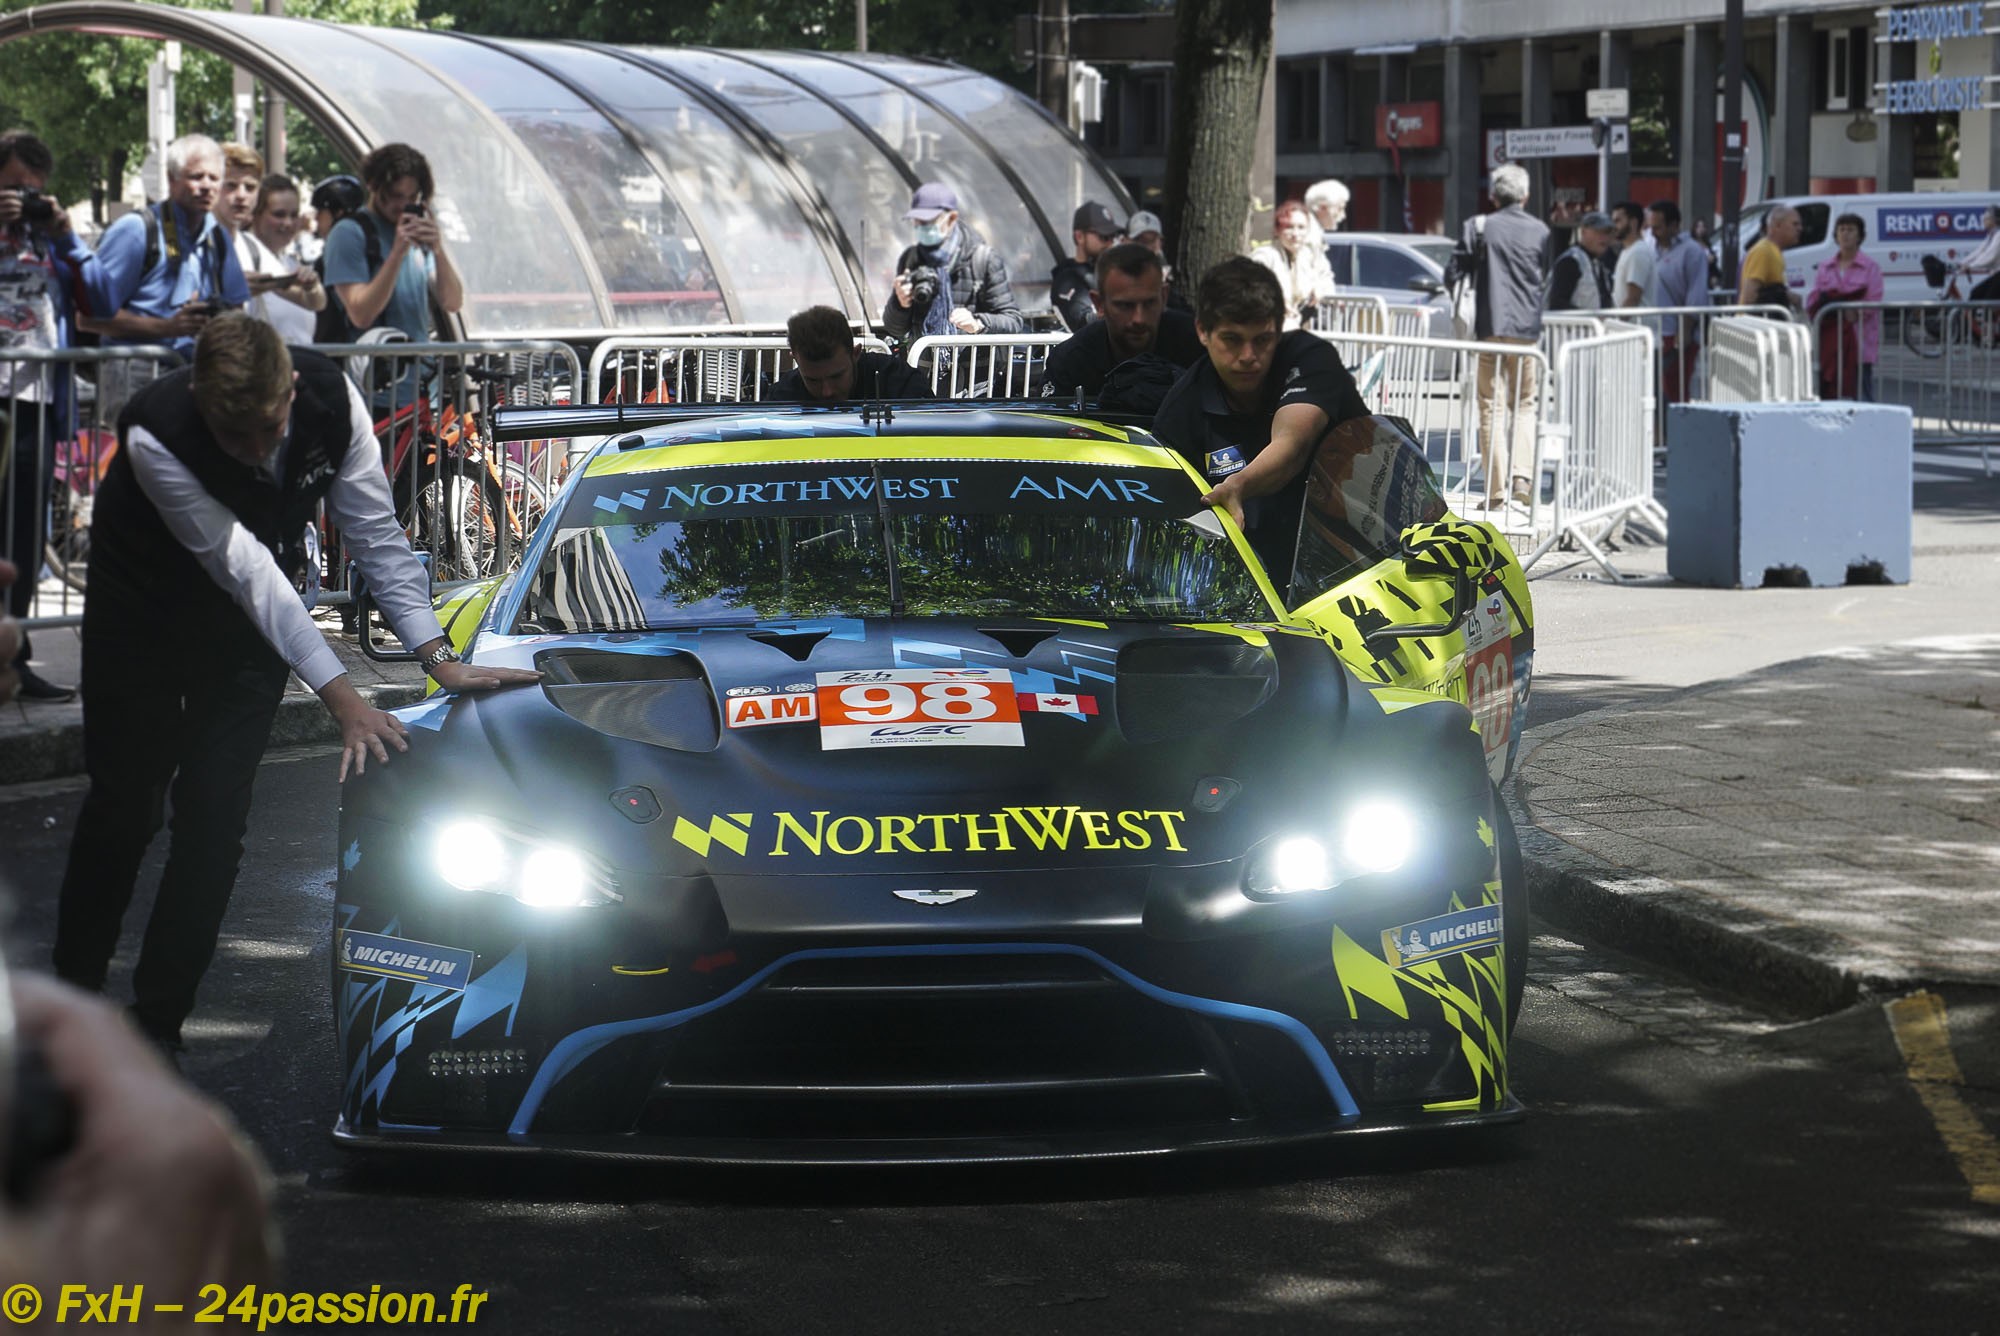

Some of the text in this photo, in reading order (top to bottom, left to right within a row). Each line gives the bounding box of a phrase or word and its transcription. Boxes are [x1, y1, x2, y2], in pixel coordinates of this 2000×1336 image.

[1888, 3, 1983, 41] PHARMACIE
[1887, 77, 1983, 113] HERBORISTE
[1509, 132, 1541, 143] Centre
[1544, 131, 1561, 141] des
[1564, 129, 1593, 140] Finan
[1510, 144, 1557, 155] Publiques
[1885, 214, 1933, 232] RENT
[1209, 462, 1244, 475] MICHELIN
[1009, 475, 1165, 503] AMR
[734, 696, 810, 722] AM
[839, 682, 998, 723] 98
[870, 725, 973, 736] WEC
[353, 946, 457, 976] MICHELIN
